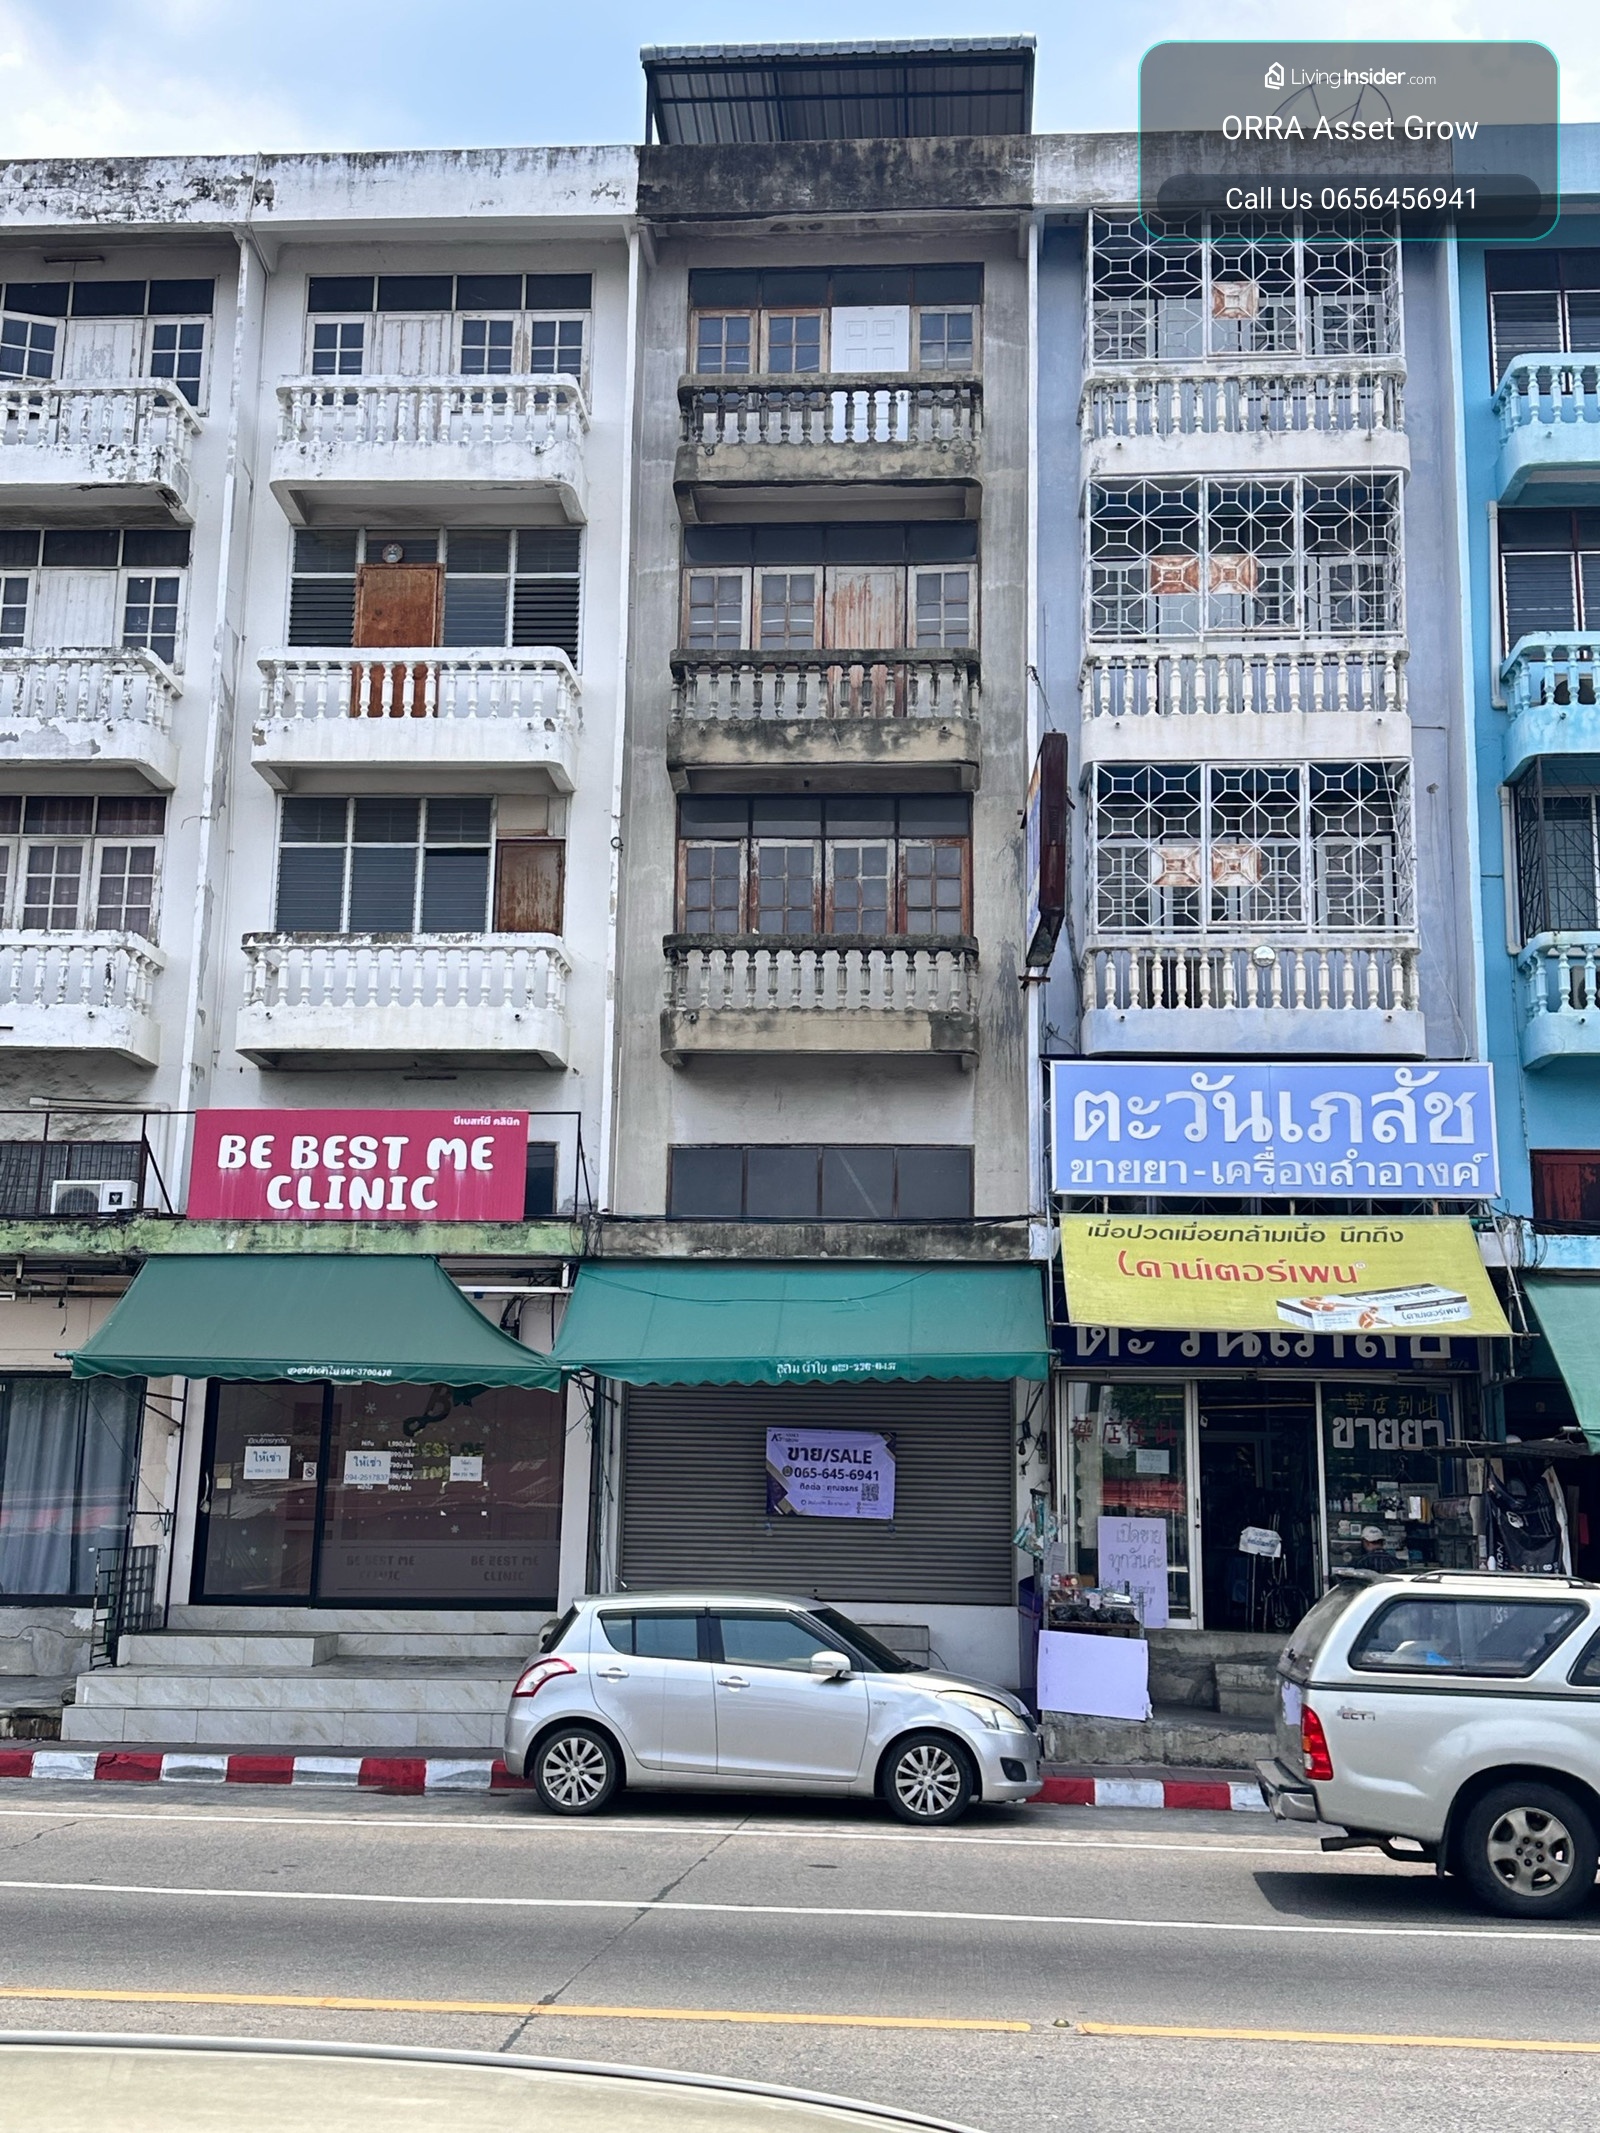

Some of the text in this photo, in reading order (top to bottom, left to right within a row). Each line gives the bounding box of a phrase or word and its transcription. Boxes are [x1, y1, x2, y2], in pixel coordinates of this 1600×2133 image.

[1073, 1067, 1479, 1145] ตะวันเภสัช
[217, 1134, 495, 1172] BE BEST ME
[266, 1174, 438, 1211] CLINIC
[1087, 1219, 1404, 1243] เมื่อปวดเมื่อยกล้ามเนื้อ นึกถึง
[1332, 1416, 1446, 1451] ขายยา
[253, 1450, 282, 1462] ให้เช่า
[353, 1455, 382, 1467] ให้เช่า
[787, 1447, 872, 1465] ขาย/SALE
[794, 1467, 879, 1481] 065-645-6941
